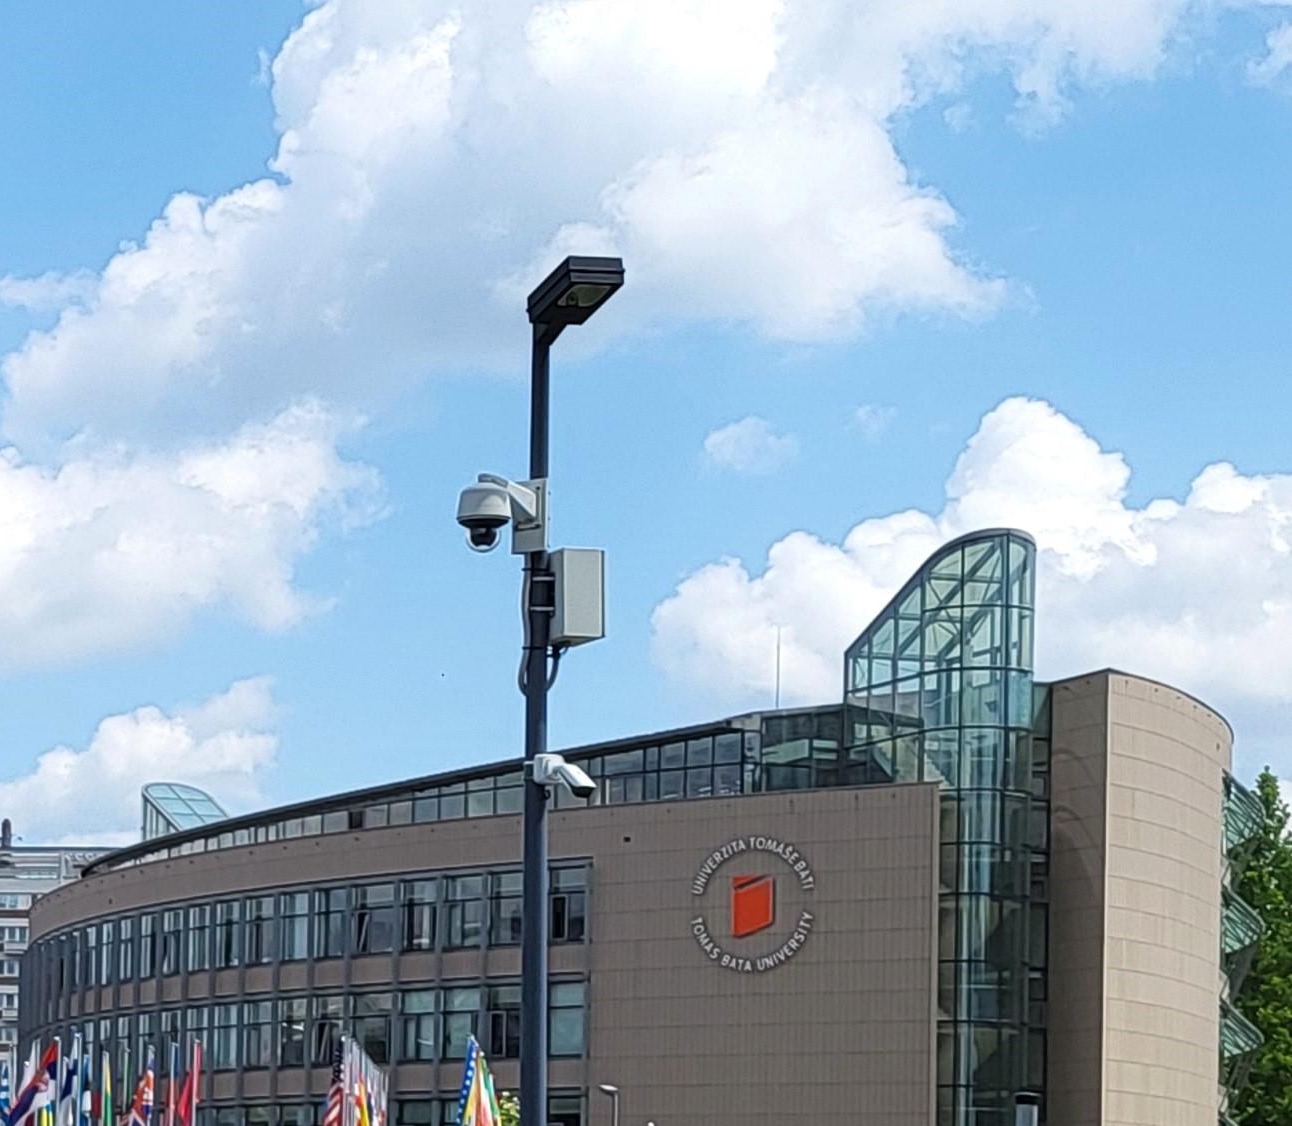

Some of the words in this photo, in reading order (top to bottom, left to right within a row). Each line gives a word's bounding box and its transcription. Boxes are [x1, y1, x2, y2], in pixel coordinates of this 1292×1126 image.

[691, 839, 747, 896] UNIVERZITA
[794, 860, 815, 890] BATI
[690, 916, 721, 959] TOMAS
[720, 954, 752, 972] BATA
[756, 911, 814, 971] UNIVERSITY
